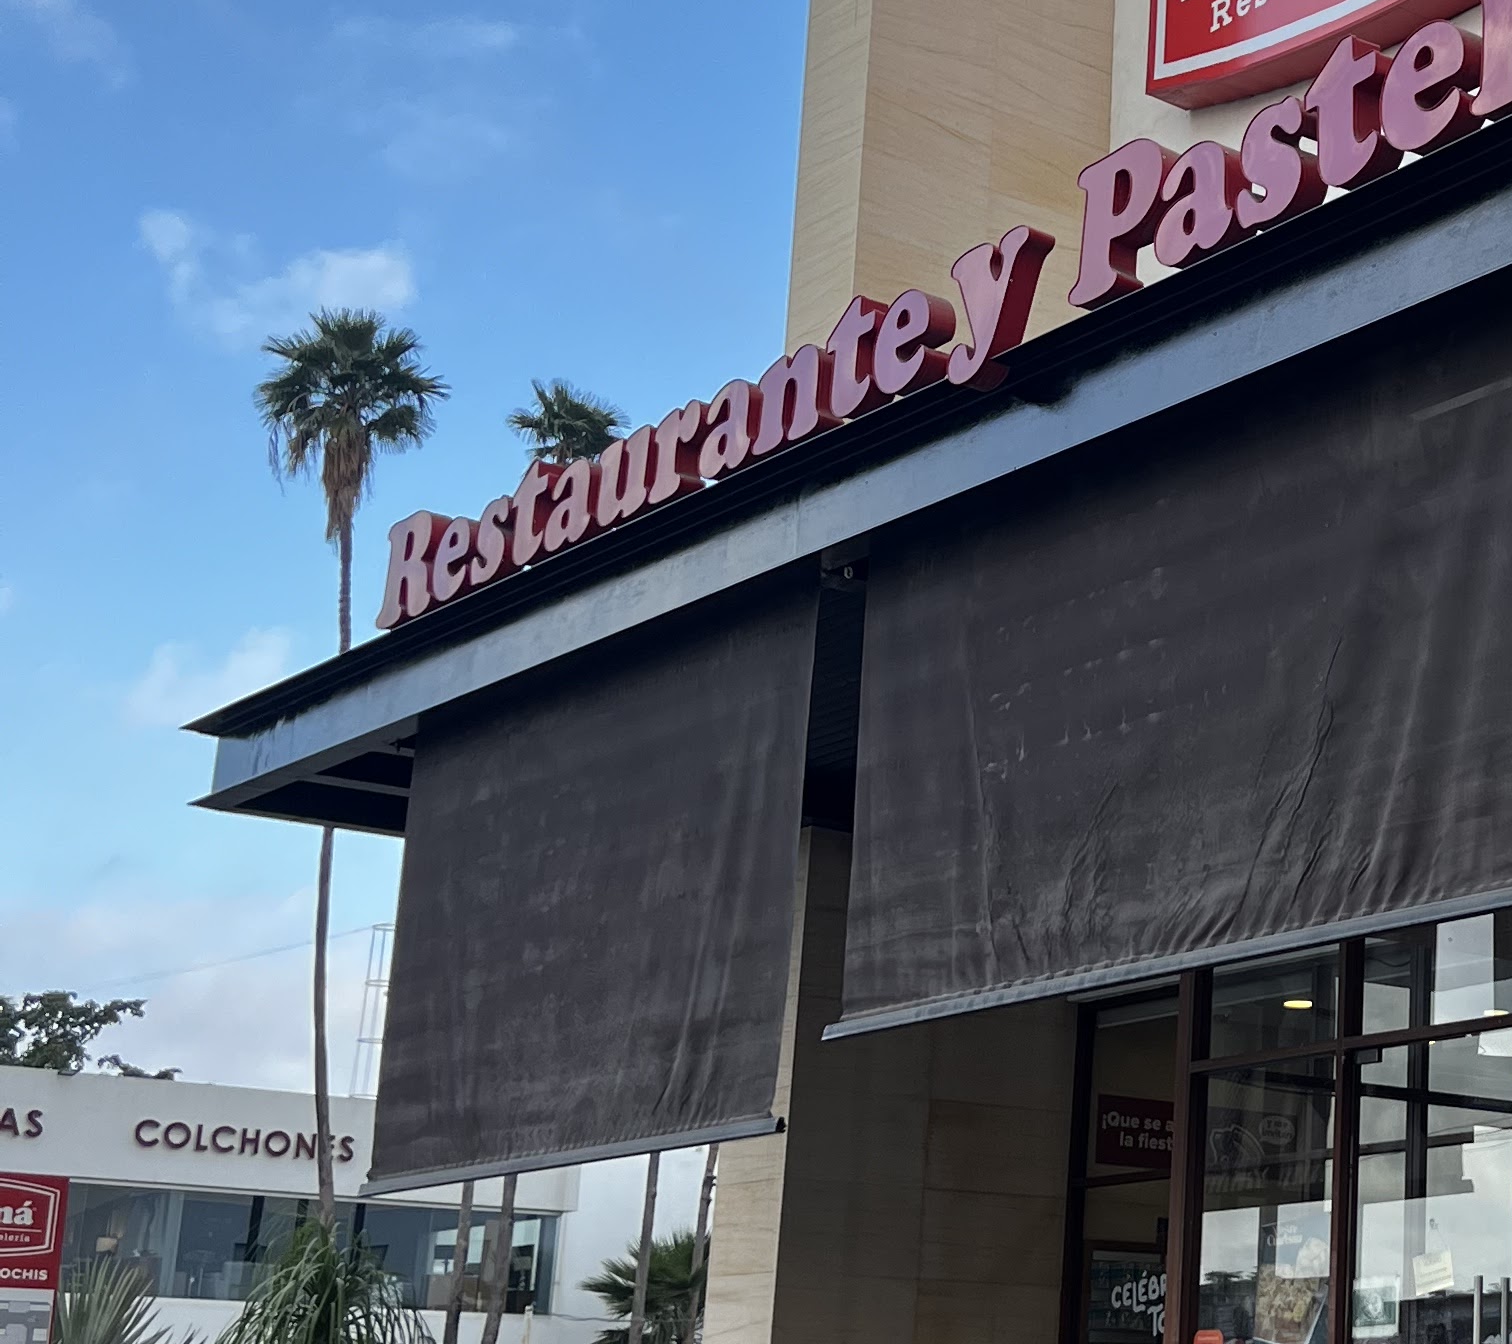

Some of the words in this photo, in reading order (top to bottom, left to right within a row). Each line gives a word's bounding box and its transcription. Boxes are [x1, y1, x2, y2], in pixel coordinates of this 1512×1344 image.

[376, 288, 956, 630] Restaurante
[947, 224, 1056, 392] y
[1144, 1116, 1161, 1131] se
[1119, 1131, 1134, 1147] la
